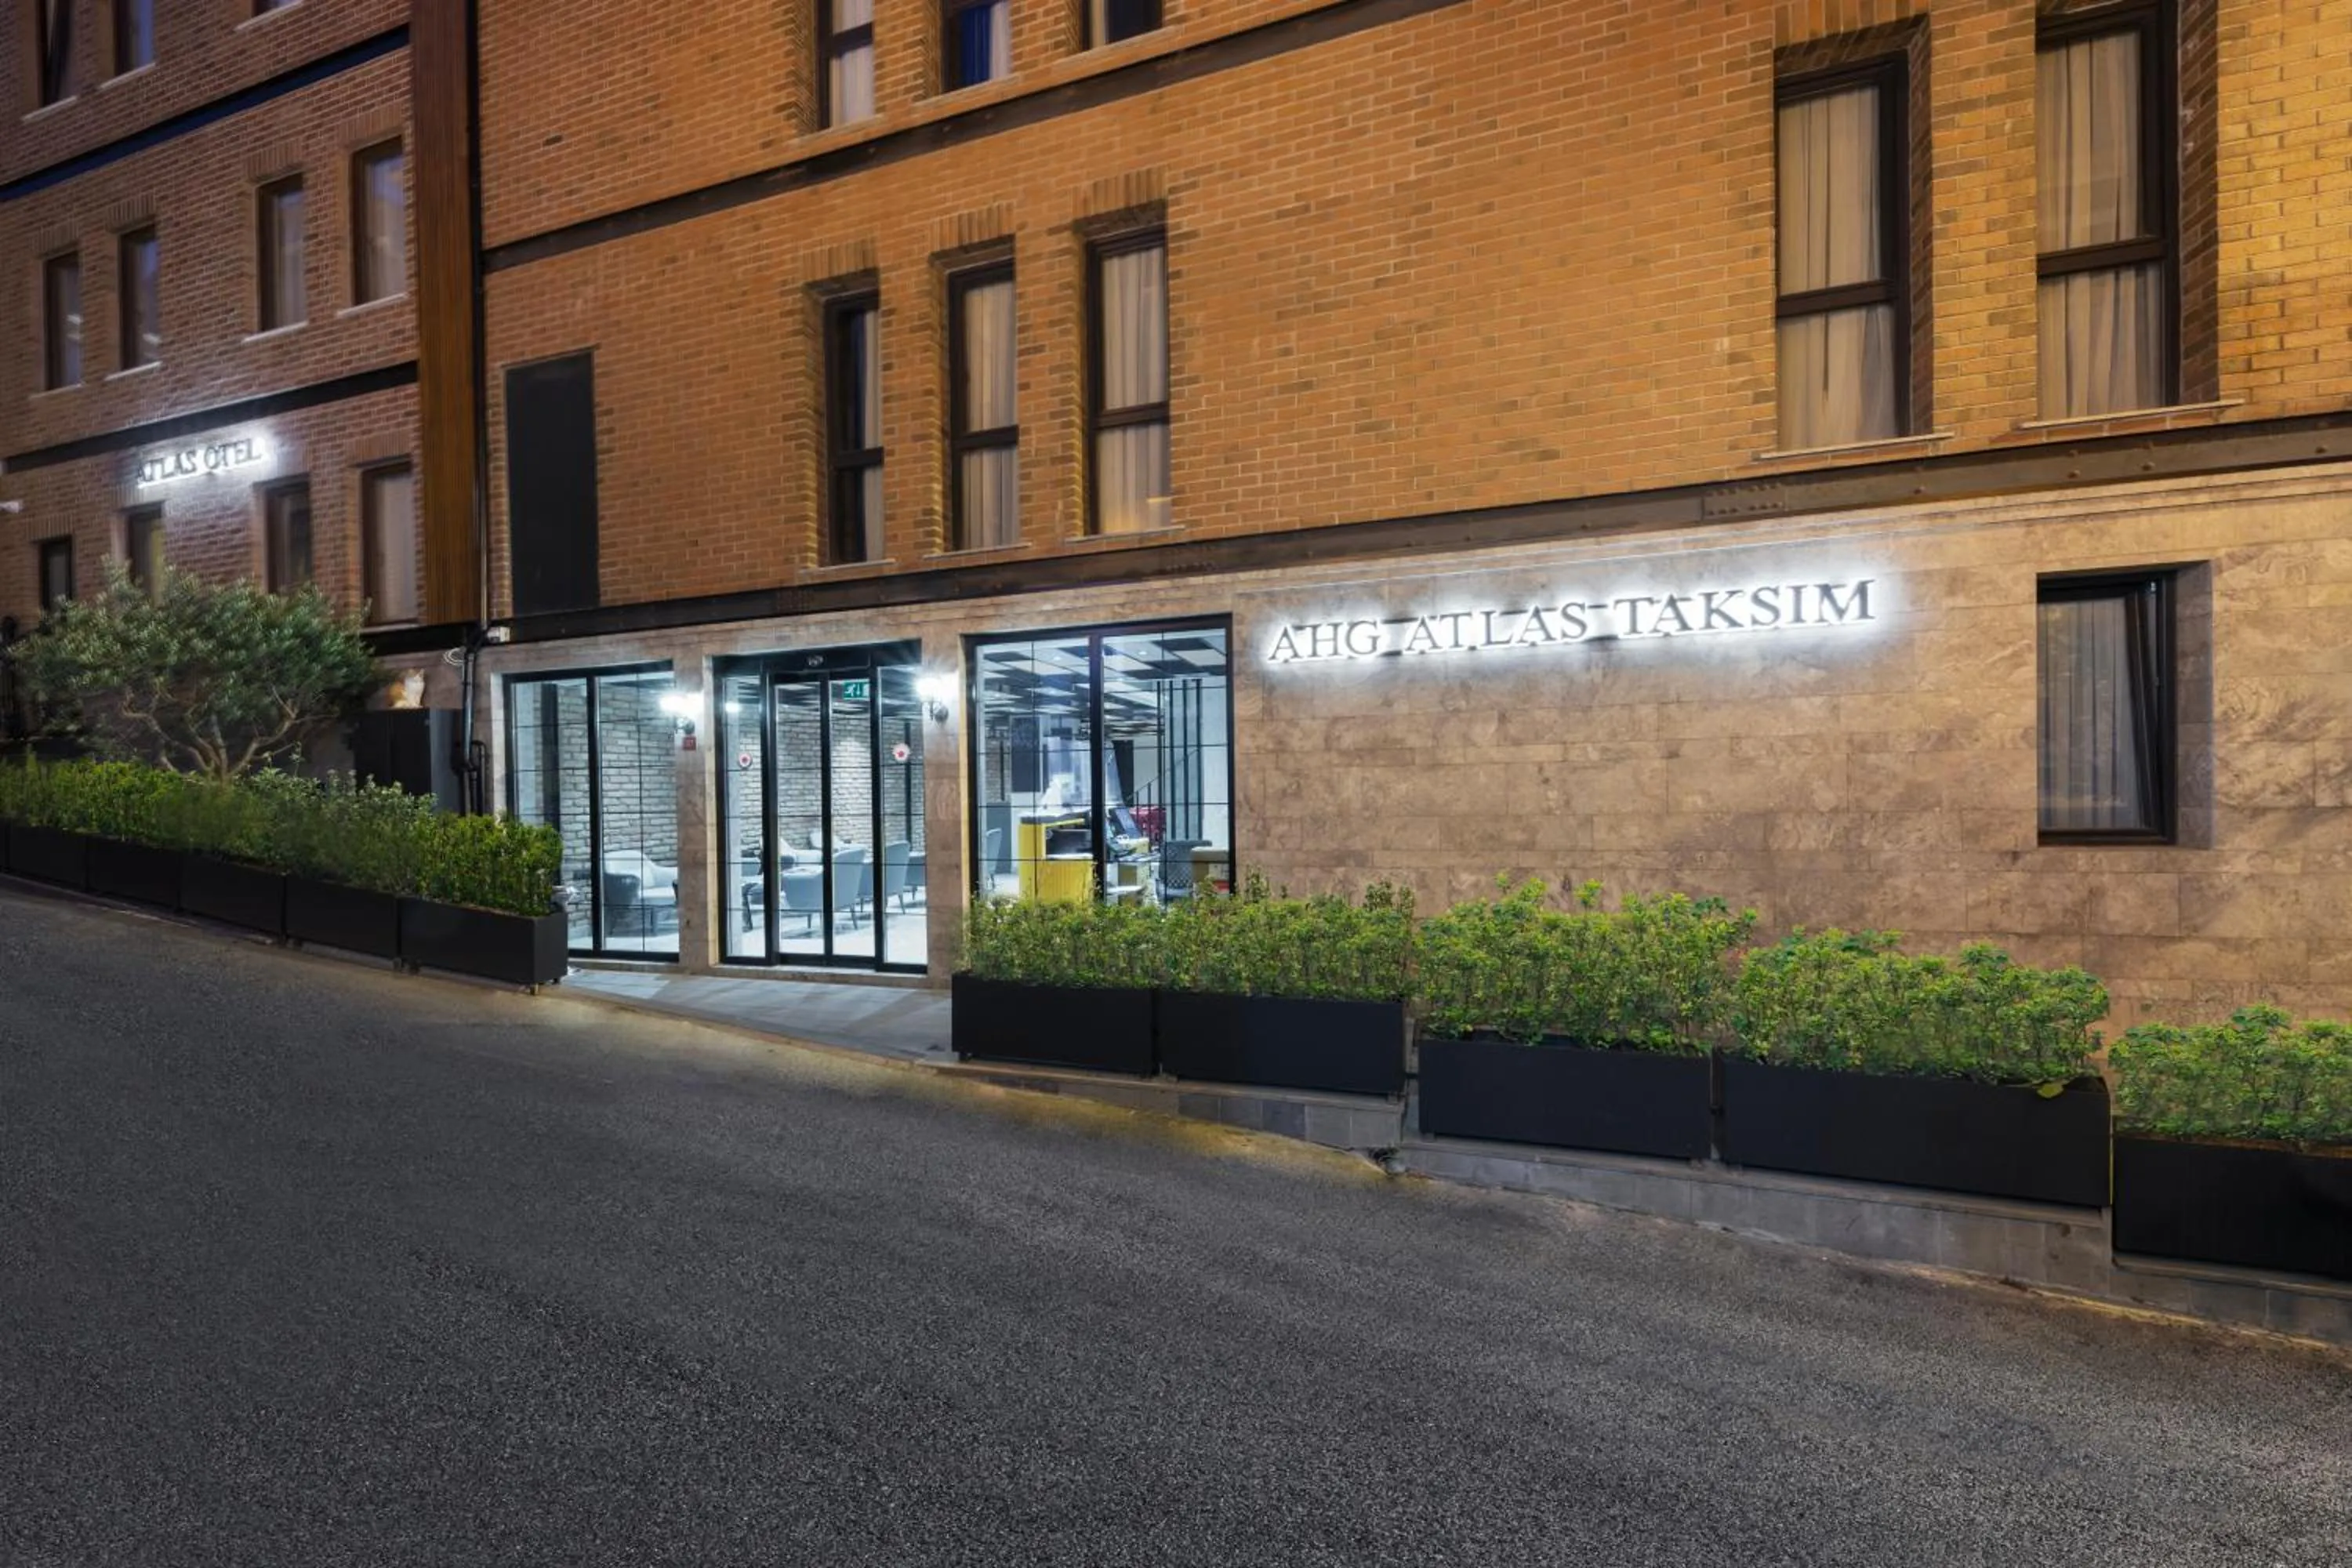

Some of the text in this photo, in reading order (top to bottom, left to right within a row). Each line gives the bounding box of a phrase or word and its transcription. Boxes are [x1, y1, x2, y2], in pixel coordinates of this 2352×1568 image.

[137, 438, 262, 482] ATLAS OTEL
[1268, 579, 1875, 660] AHG ATLAS TAKSIM
